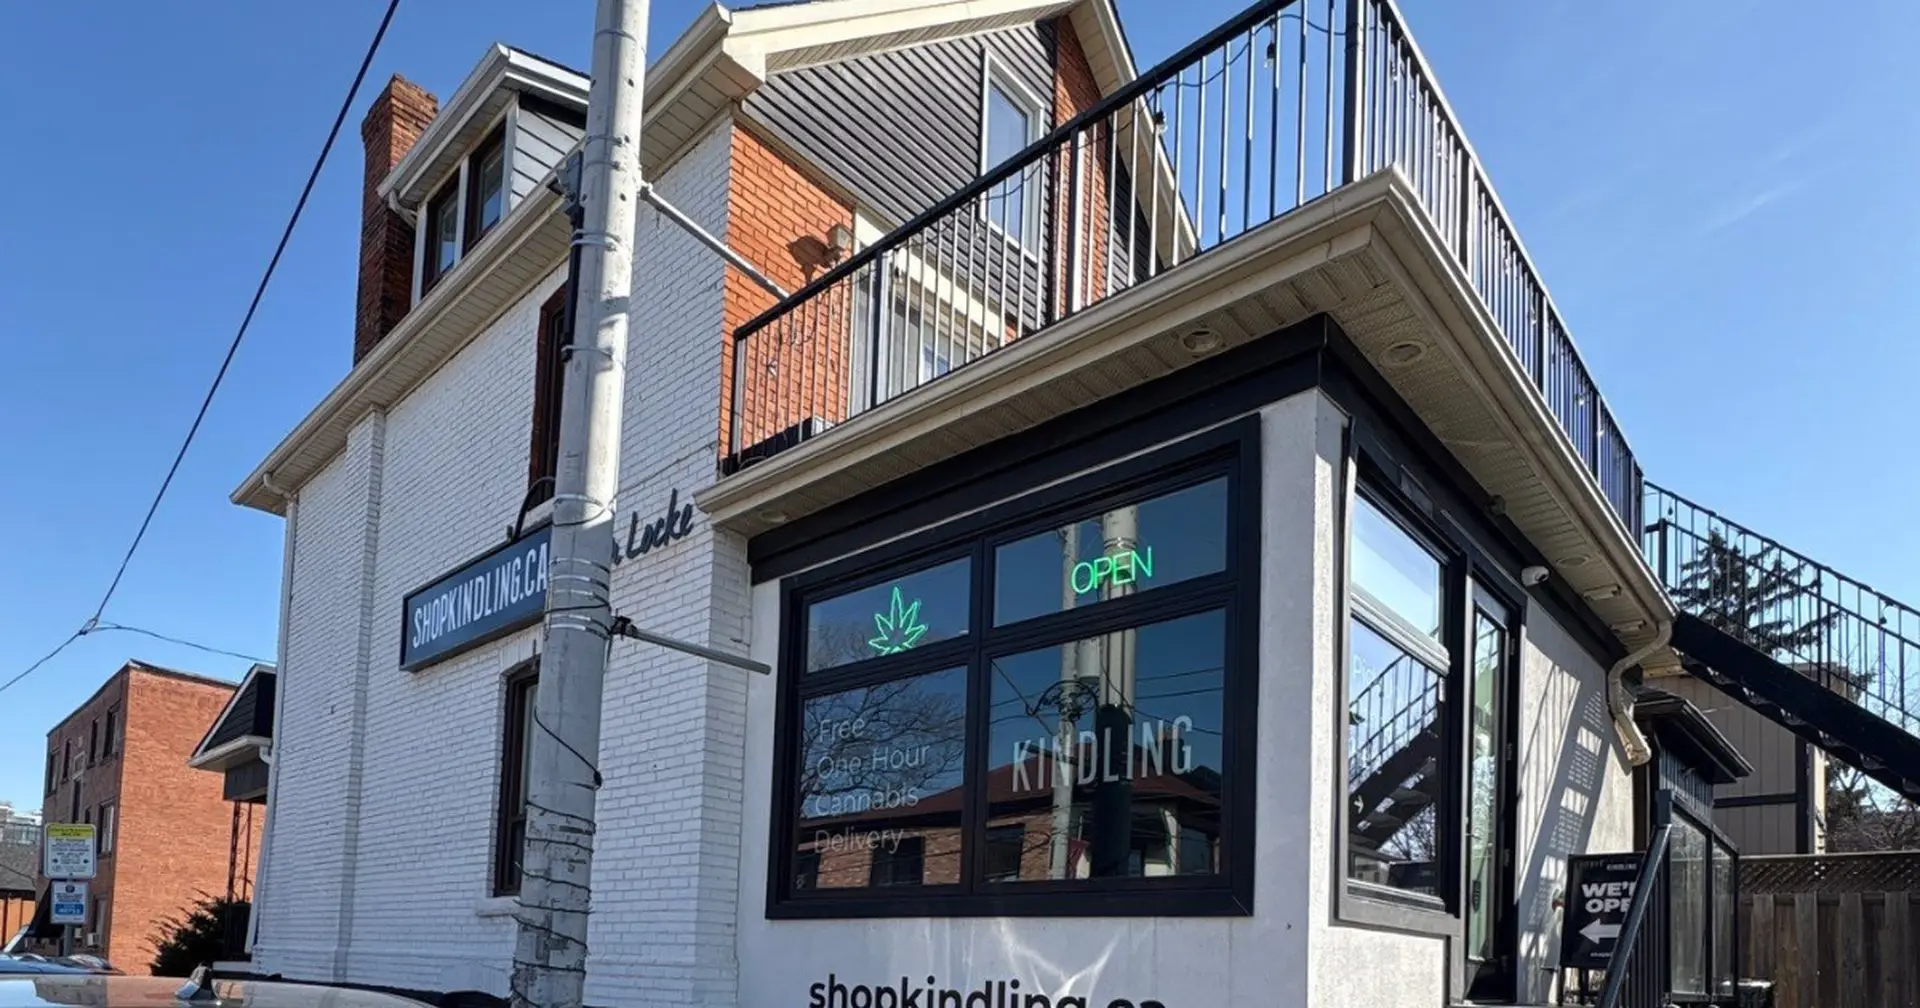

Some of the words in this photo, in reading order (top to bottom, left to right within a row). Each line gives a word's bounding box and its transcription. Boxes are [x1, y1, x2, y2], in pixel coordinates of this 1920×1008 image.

[626, 487, 694, 559] Locke
[1071, 545, 1152, 594] OPEN
[412, 541, 548, 649] SHOPKINDLING.CA
[819, 717, 866, 743] Free
[816, 756, 862, 779] One
[871, 744, 930, 772] Hour
[1012, 715, 1193, 793] KINDLING
[815, 782, 920, 817] Cannabis
[814, 826, 904, 855] Delivery
[1581, 881, 1637, 898] WE'
[1585, 898, 1631, 913] OPE
[809, 973, 1167, 1008] shopkindlin
